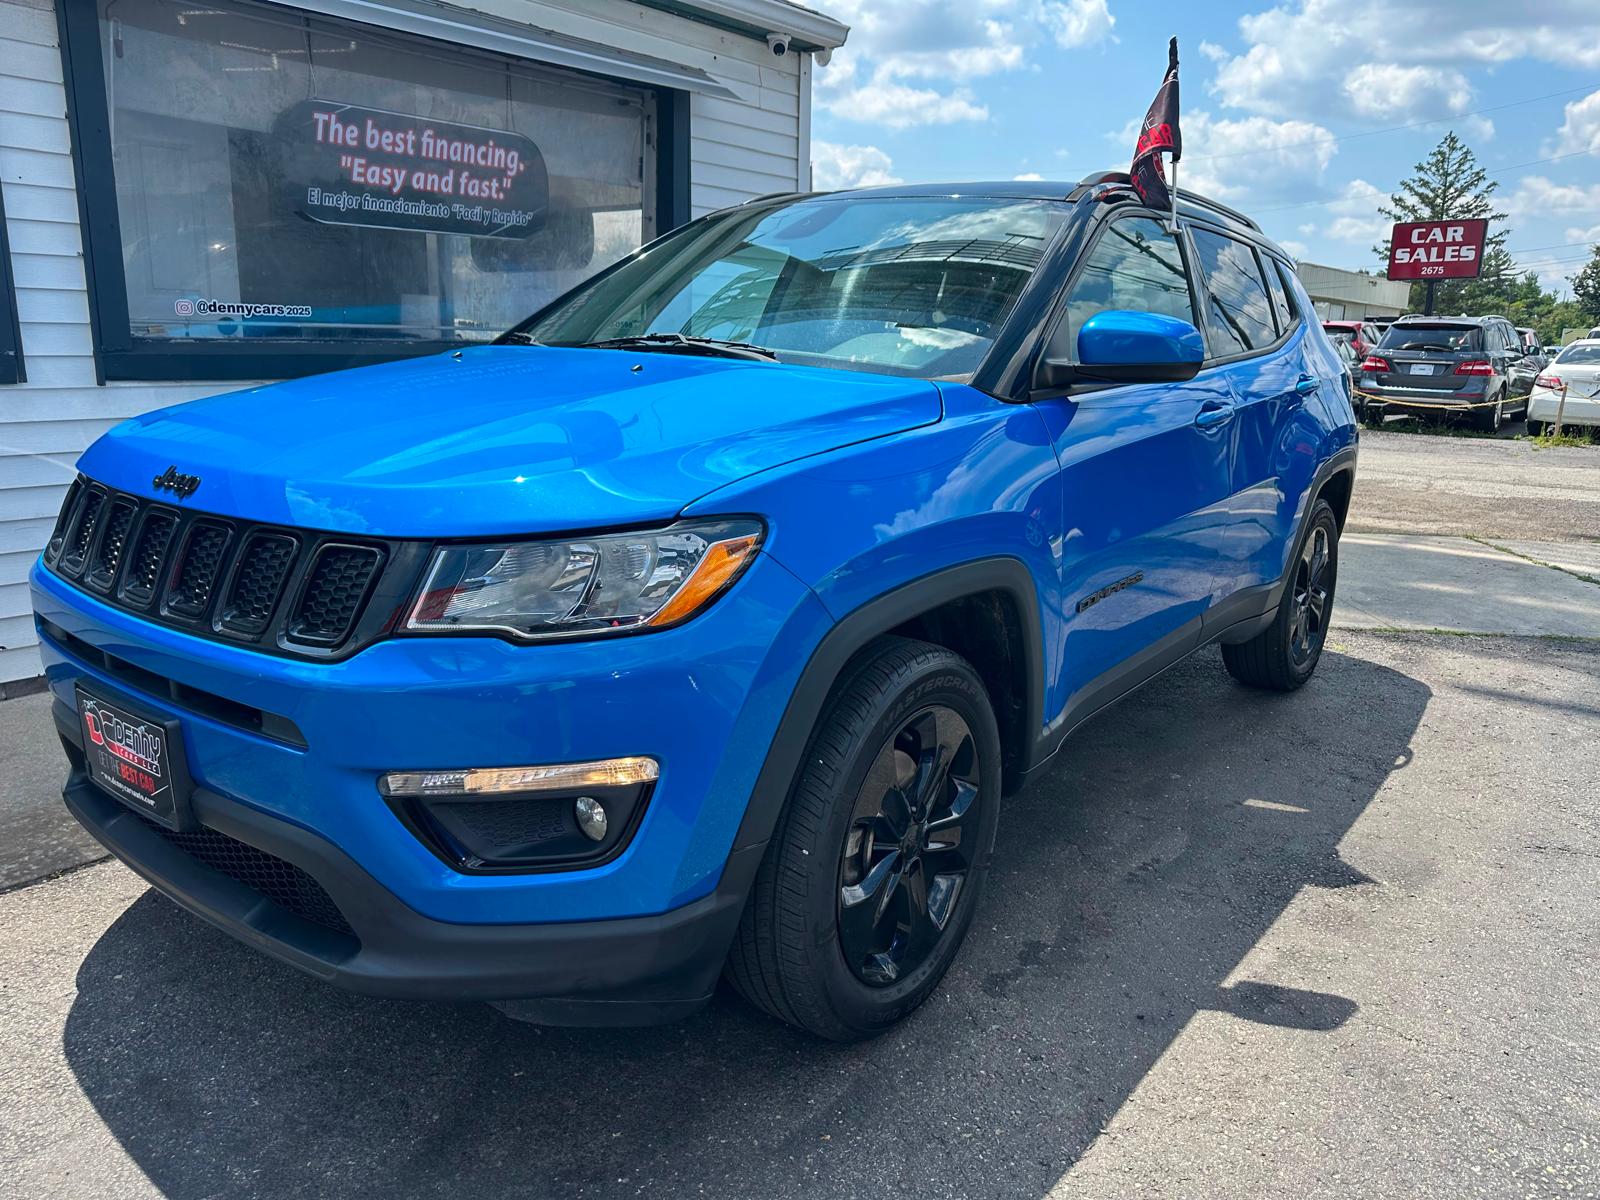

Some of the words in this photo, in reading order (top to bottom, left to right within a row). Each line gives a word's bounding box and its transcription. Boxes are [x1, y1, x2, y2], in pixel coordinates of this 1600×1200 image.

[313, 112, 359, 147] The
[365, 120, 416, 156] best
[421, 129, 525, 177] financing.
[341, 155, 406, 193] "Easy
[411, 168, 454, 194] and
[460, 171, 512, 200] fast."
[308, 188, 321, 205] El
[322, 192, 361, 212] mejor
[361, 193, 449, 218] financiamiento
[482, 210, 491, 226] y
[1411, 226, 1464, 244] CAR
[1395, 245, 1476, 264] SALES
[1421, 266, 1444, 275] 2675
[197, 300, 285, 318] @dennycars
[285, 305, 312, 317] 2025
[881, 674, 981, 732] MASTERCRAF
[142, 760, 157, 772] LLC
